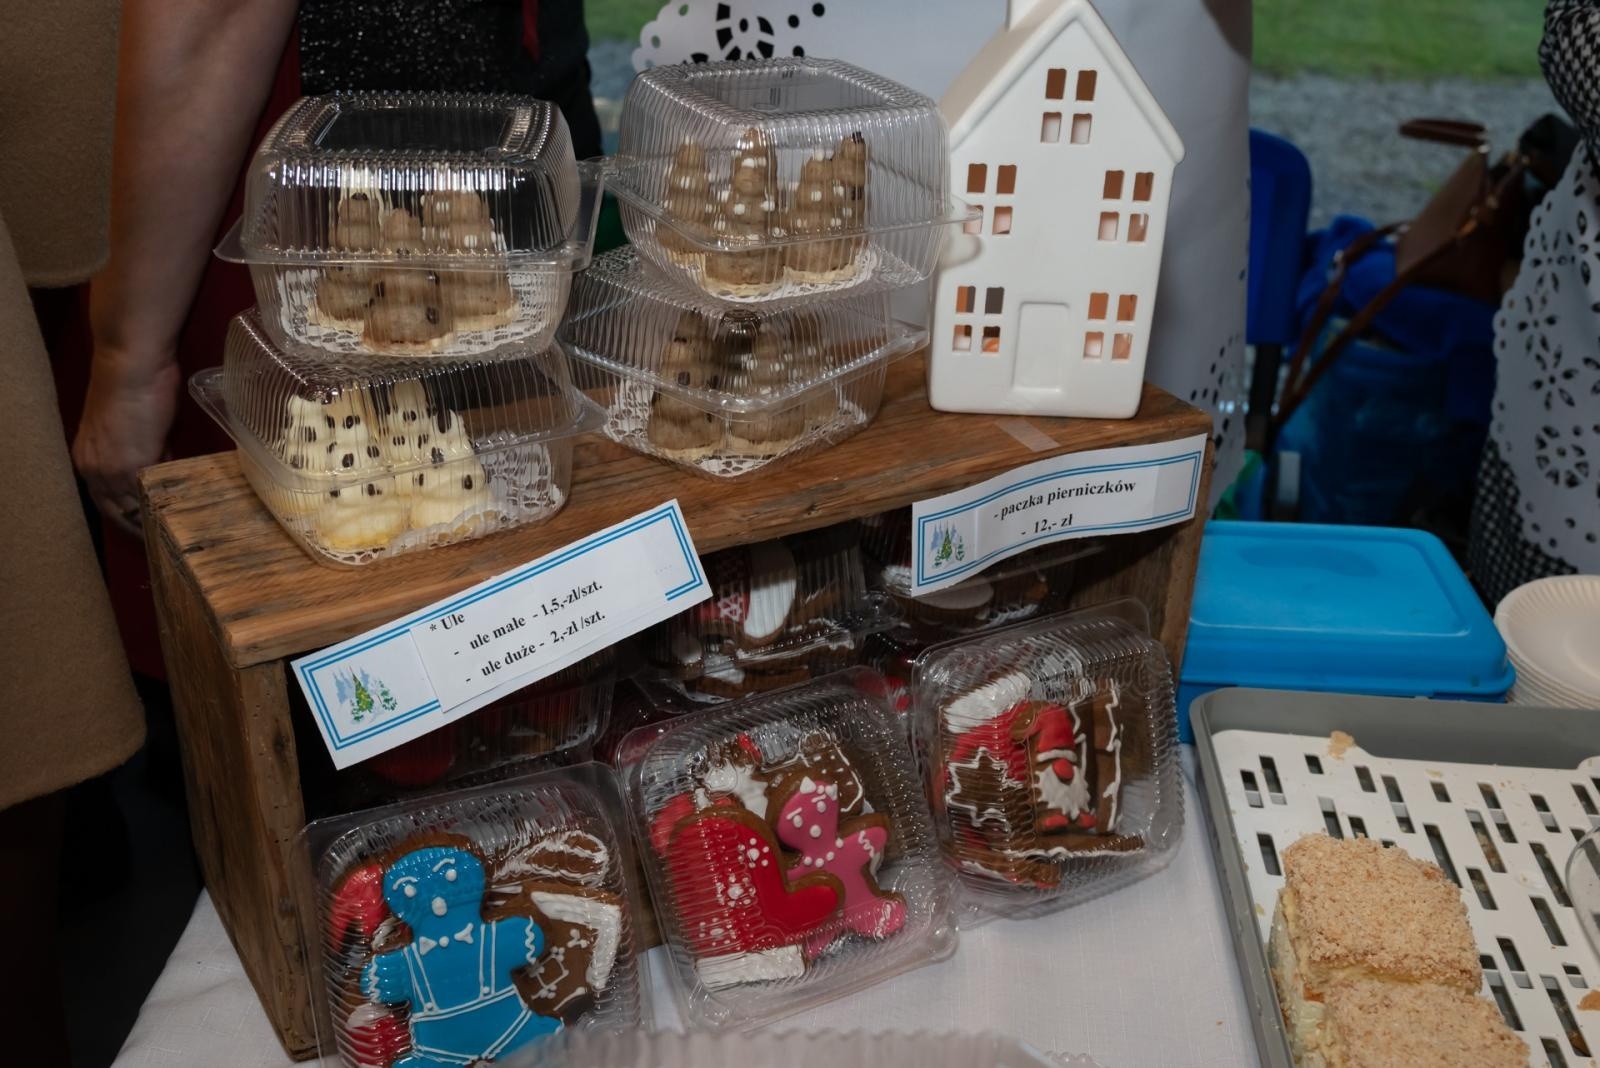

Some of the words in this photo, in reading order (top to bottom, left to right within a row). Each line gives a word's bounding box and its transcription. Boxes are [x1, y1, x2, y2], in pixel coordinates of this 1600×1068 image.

[1001, 495, 1043, 520] paczka
[1047, 480, 1136, 505] pierniczków
[1061, 514, 1072, 527] zł
[440, 614, 464, 629] Ule
[470, 634, 490, 649] ule
[481, 661, 501, 676] ule
[505, 645, 536, 664] duże
